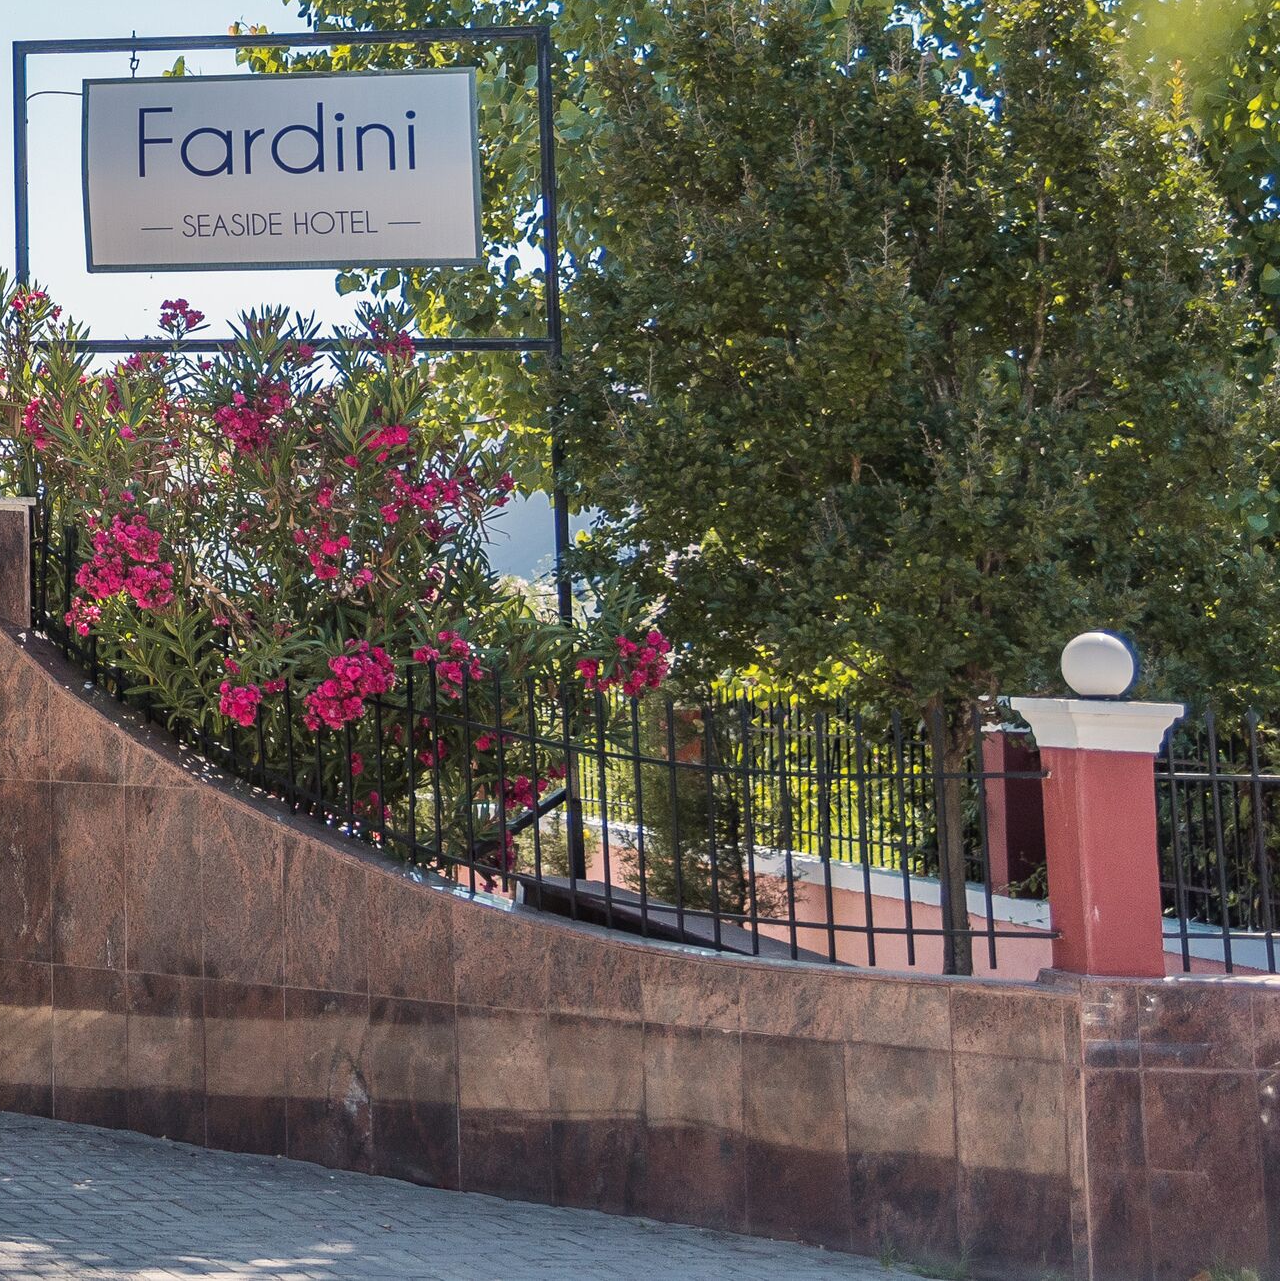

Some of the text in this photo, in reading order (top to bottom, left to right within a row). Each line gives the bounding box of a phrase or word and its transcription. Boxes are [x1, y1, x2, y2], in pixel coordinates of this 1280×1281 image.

[138, 102, 417, 178] Fardini
[182, 210, 378, 238] SEASIDE HOTEL
